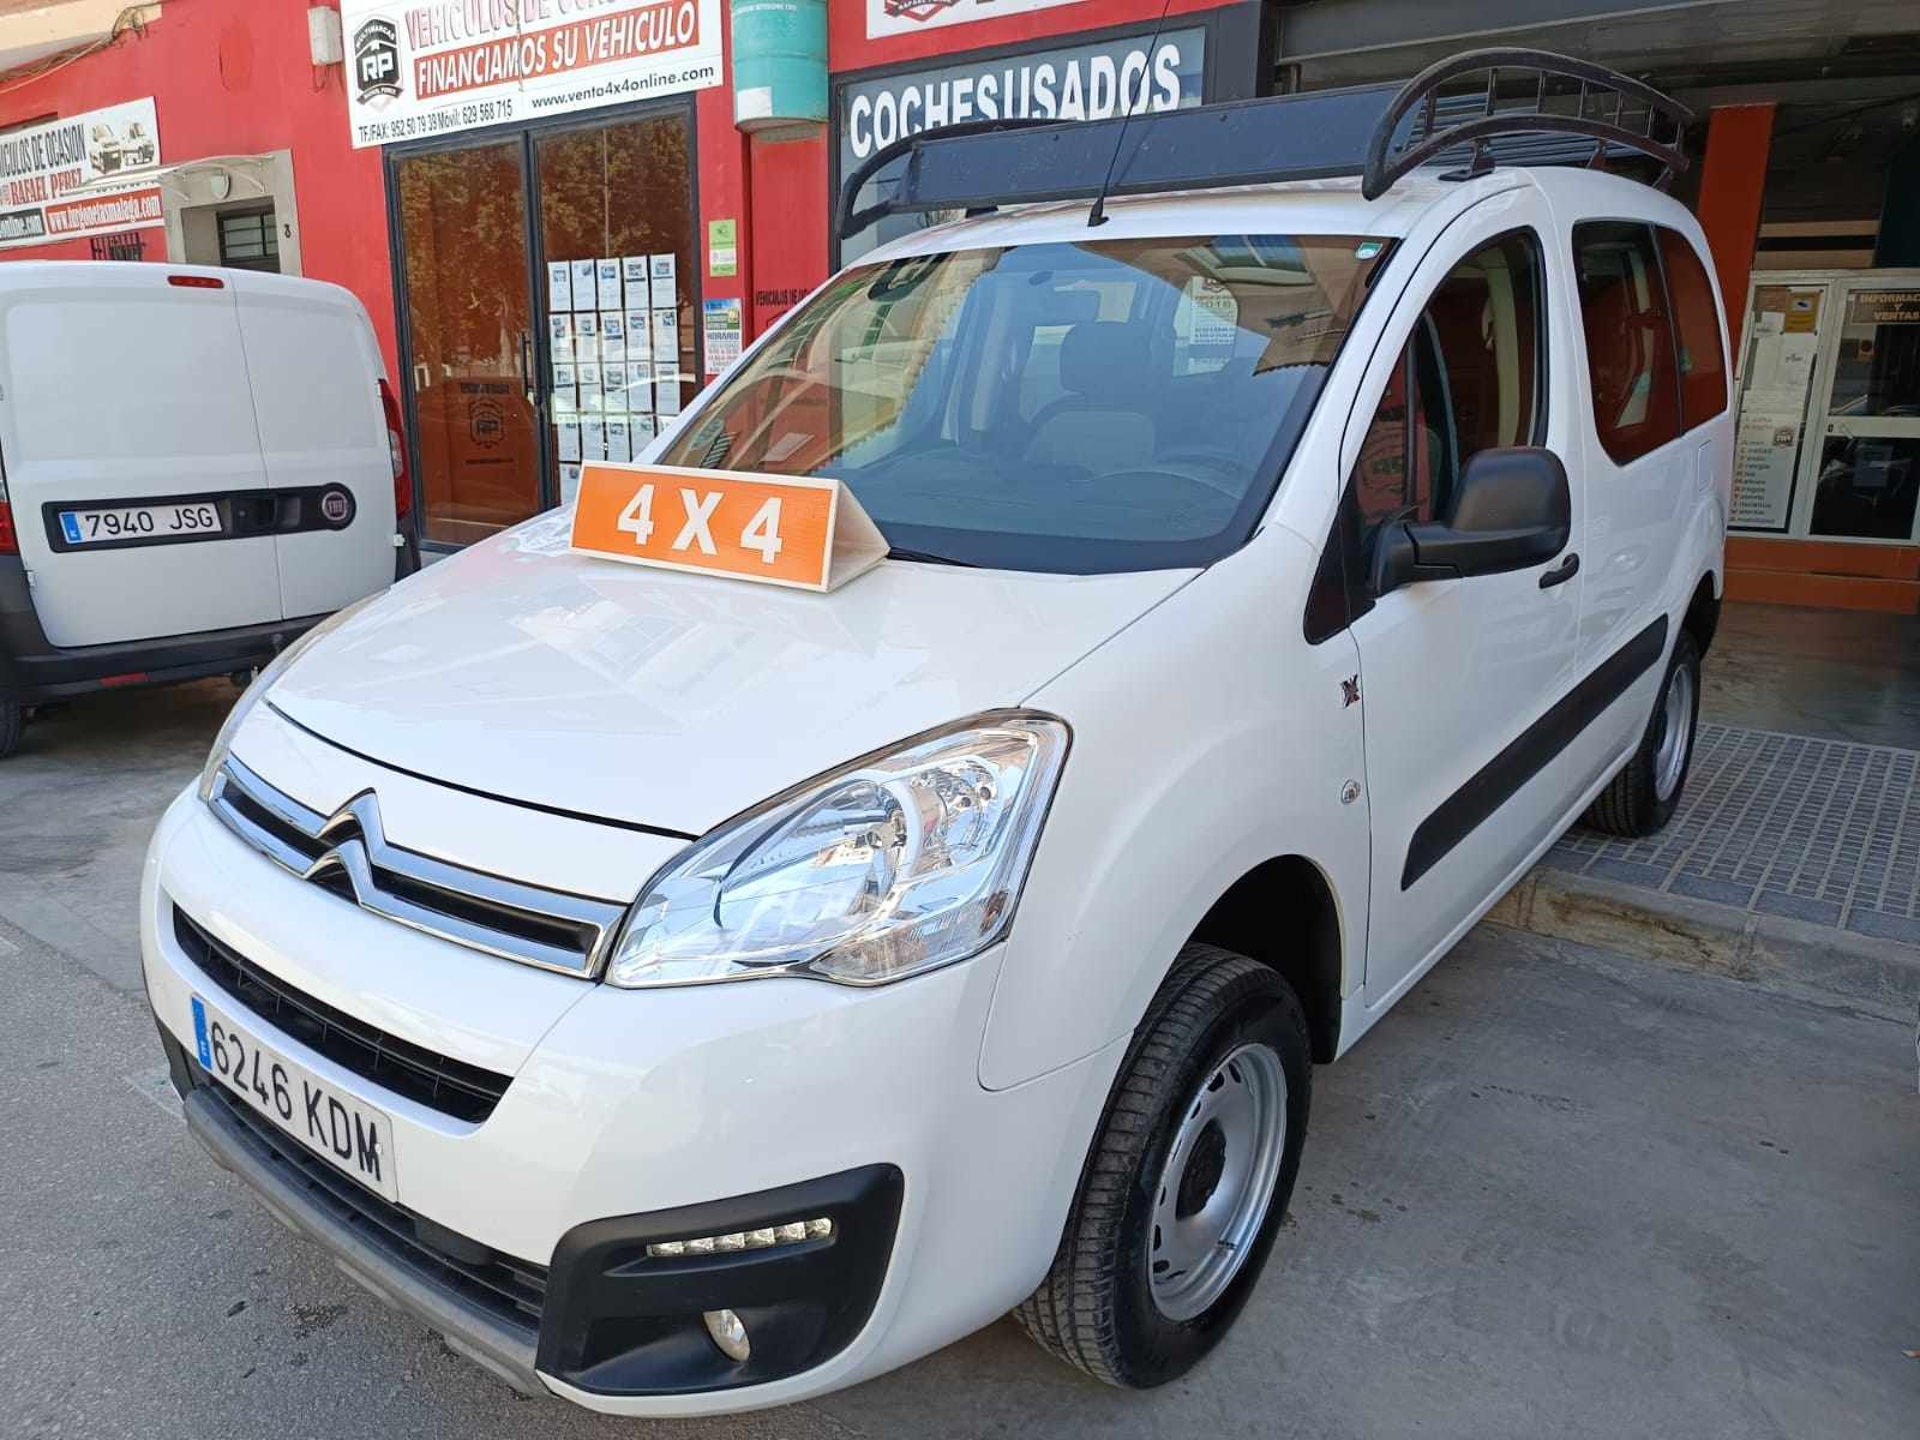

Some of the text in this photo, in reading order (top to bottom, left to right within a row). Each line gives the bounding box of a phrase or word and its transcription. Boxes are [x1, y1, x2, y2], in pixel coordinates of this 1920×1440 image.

[362, 51, 394, 82] RP
[419, 1, 694, 96] FINANCIAMOS SU VEHICULO
[391, 119, 405, 138] 952
[417, 115, 426, 133] 79
[462, 105, 477, 125] 629
[480, 103, 494, 122] 568
[497, 99, 513, 118] 715
[31, 134, 46, 170] DE
[45, 124, 87, 168] OCASION
[10, 176, 48, 206] RAFAEL
[86, 511, 155, 537] 7940
[170, 507, 214, 530] JSG
[617, 484, 782, 564] 4 X 4
[211, 1021, 292, 1120] 6246
[304, 1080, 381, 1181] KDM
